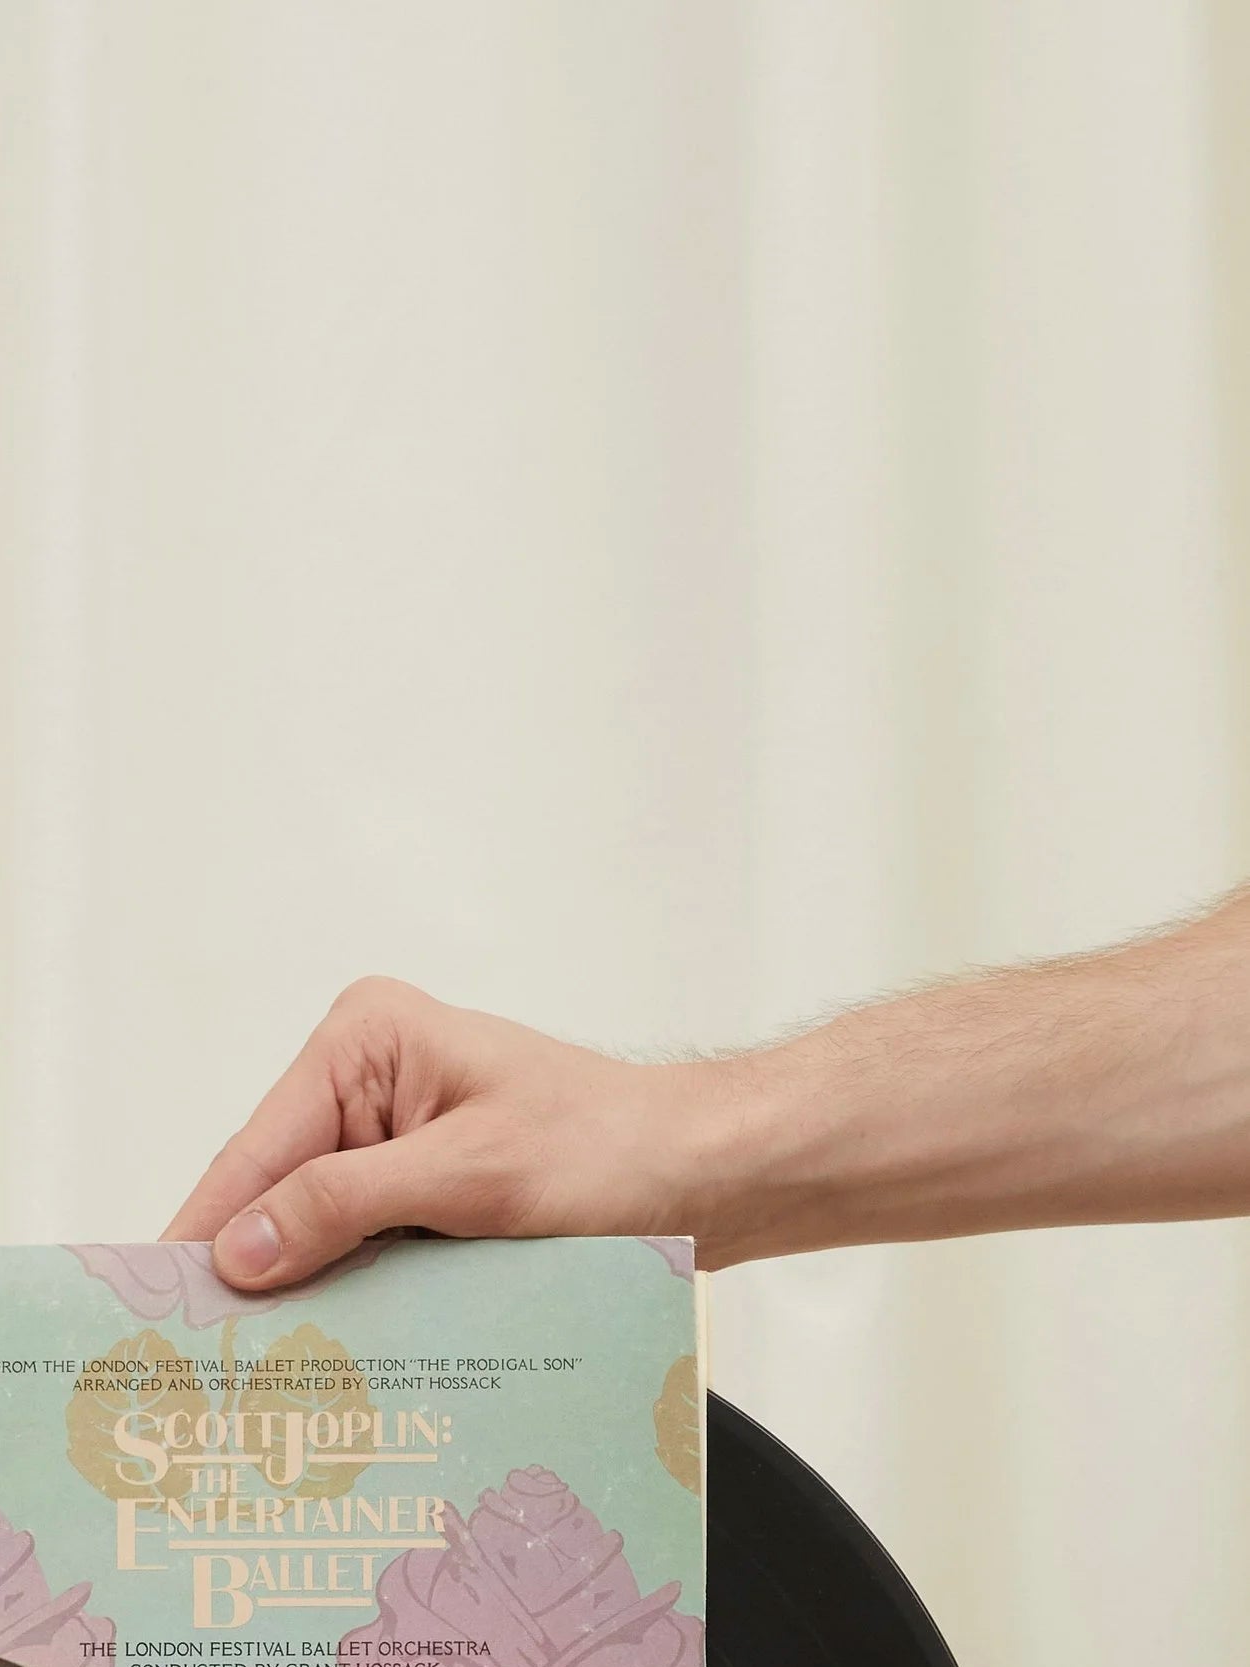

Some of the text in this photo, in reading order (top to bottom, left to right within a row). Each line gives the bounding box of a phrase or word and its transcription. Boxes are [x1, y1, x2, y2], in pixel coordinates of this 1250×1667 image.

[42, 1360, 76, 1373] THE
[82, 1360, 149, 1373] LONDON
[156, 1359, 229, 1373] FESTIVAL
[234, 1359, 294, 1373] BALLET
[301, 1358, 406, 1372] PRODUCTION
[457, 1358, 538, 1371] PRODIGAL
[72, 1376, 502, 1392] ARRANGED AND ORCHESTRATED BY GRANT HOSSACK
[114, 1410, 452, 1486] SCOTT JOPLIN:
[185, 1468, 249, 1494] THE
[115, 1496, 446, 1571] ENTERTAINER
[193, 1554, 382, 1629] BALLET
[79, 1640, 491, 1657] THE LONDON FESTIVAL BALLET ORCHESTRA
